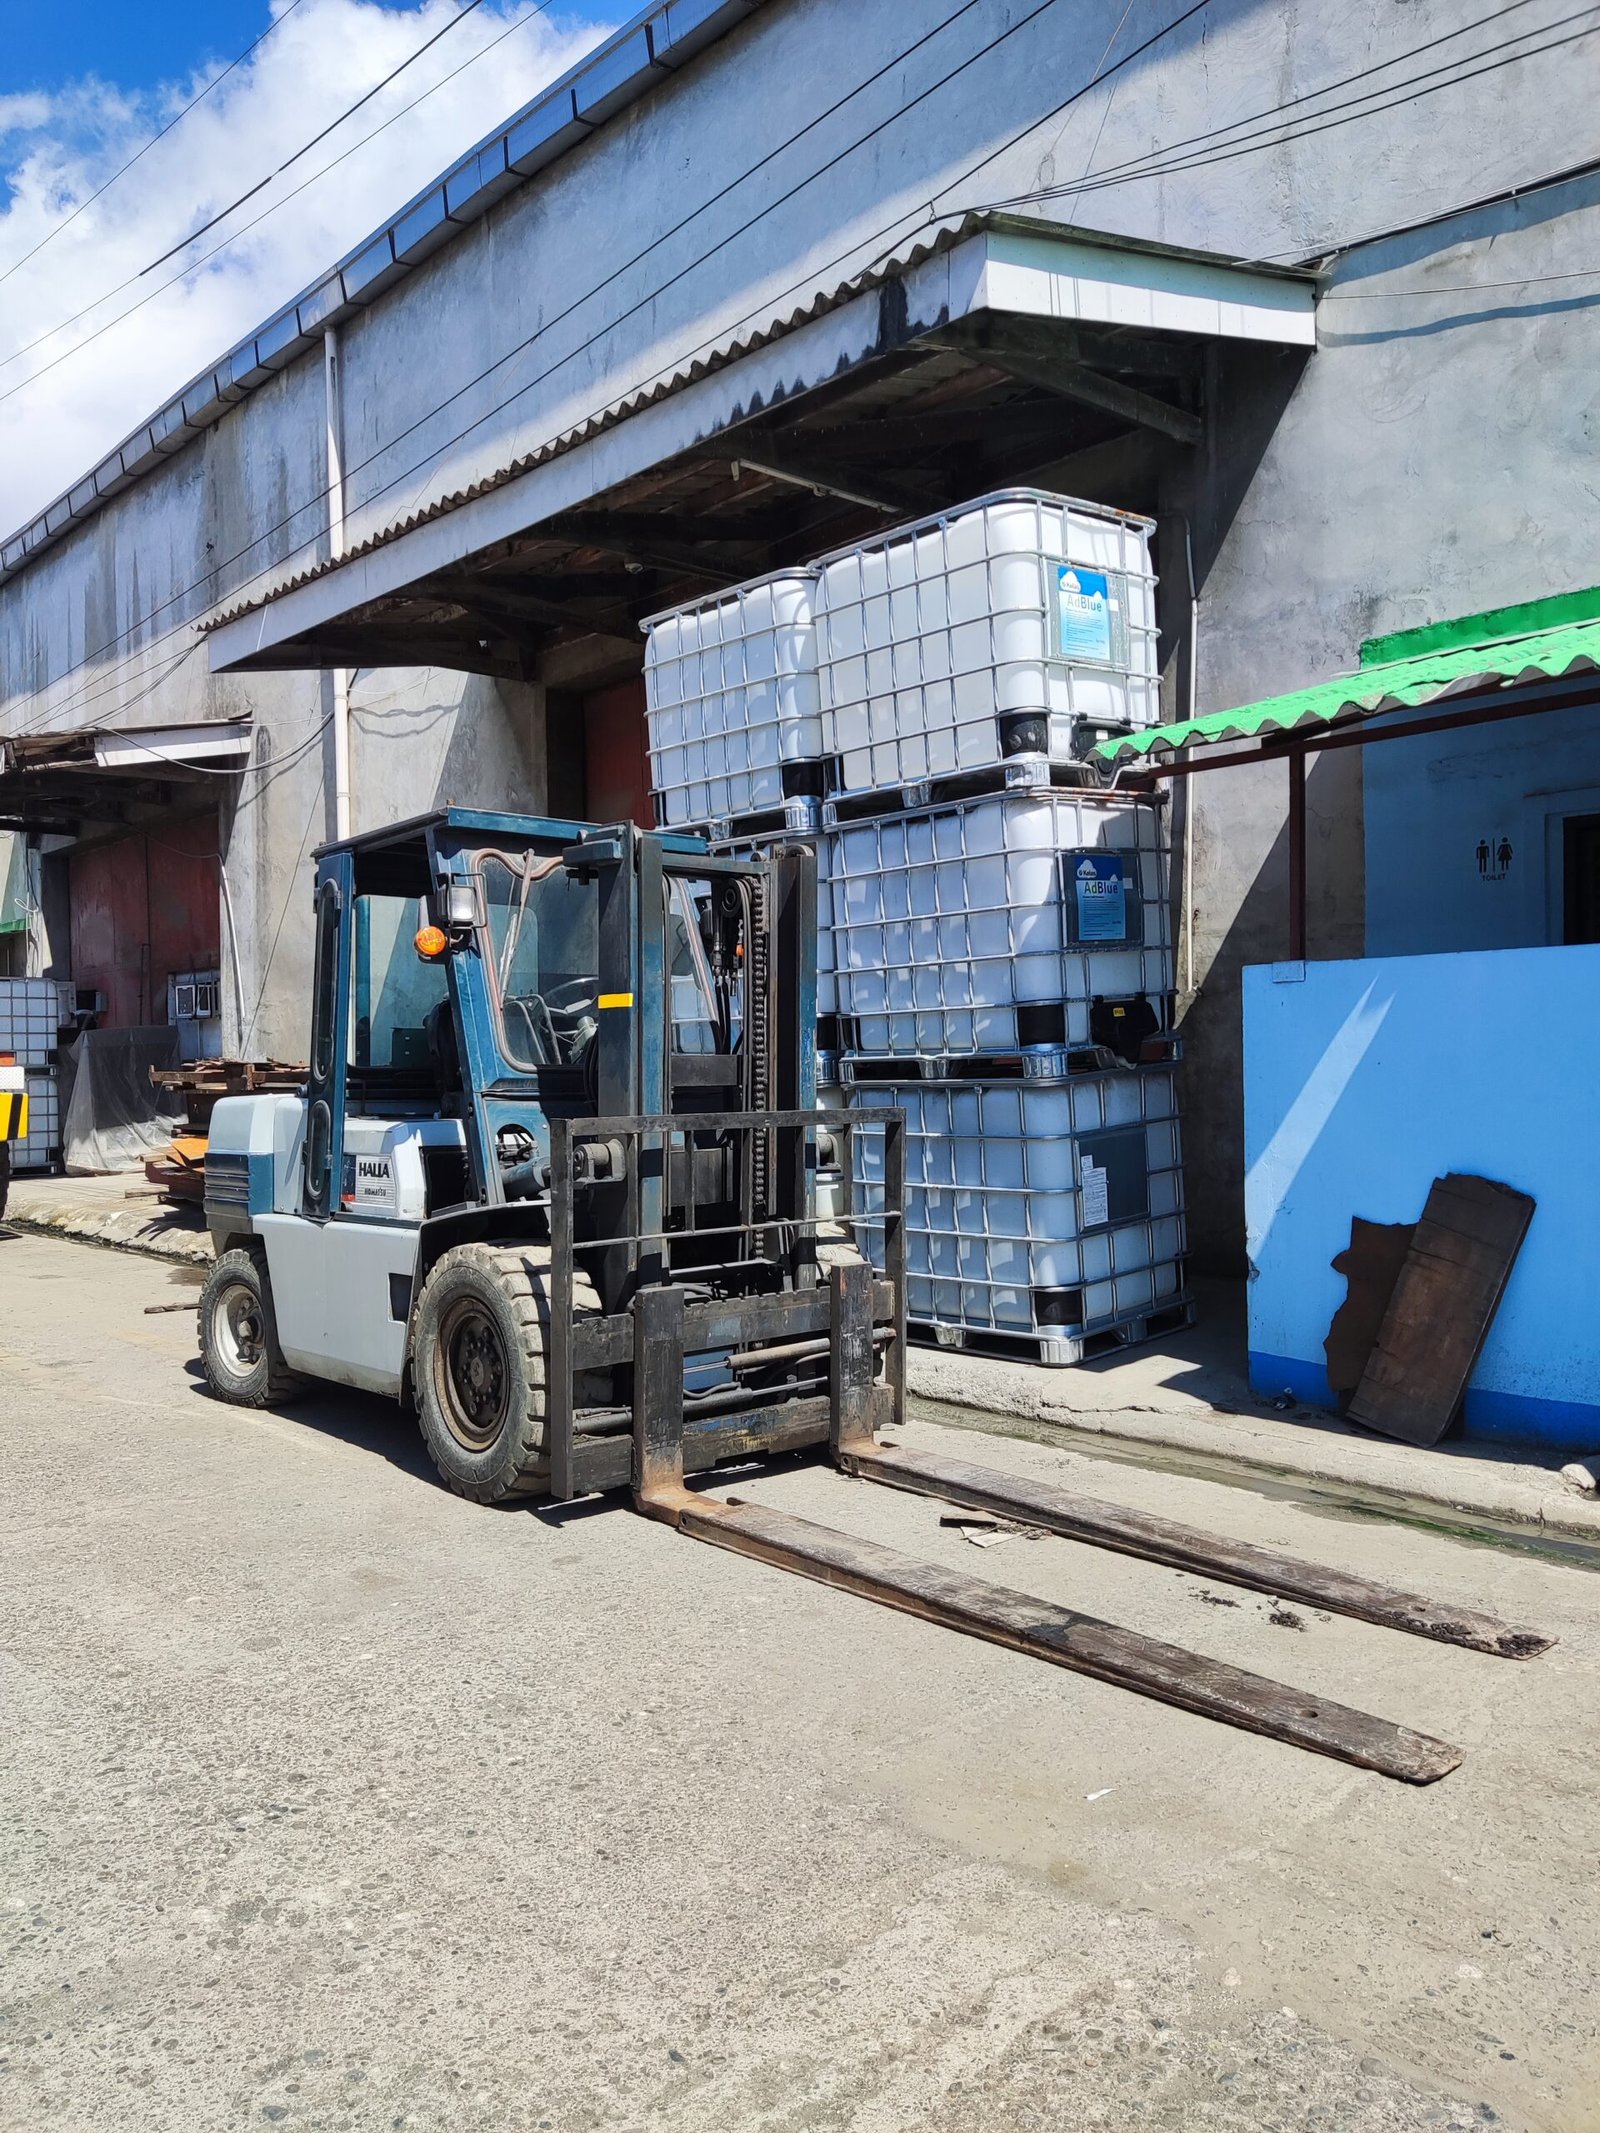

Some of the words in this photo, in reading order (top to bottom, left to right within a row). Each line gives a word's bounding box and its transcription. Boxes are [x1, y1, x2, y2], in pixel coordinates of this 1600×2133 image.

[1067, 594, 1102, 612] AdBlue
[1482, 873, 1506, 881] TOILET
[1084, 881, 1118, 894] AdBlue
[364, 1187, 387, 1197] KOMATSU
